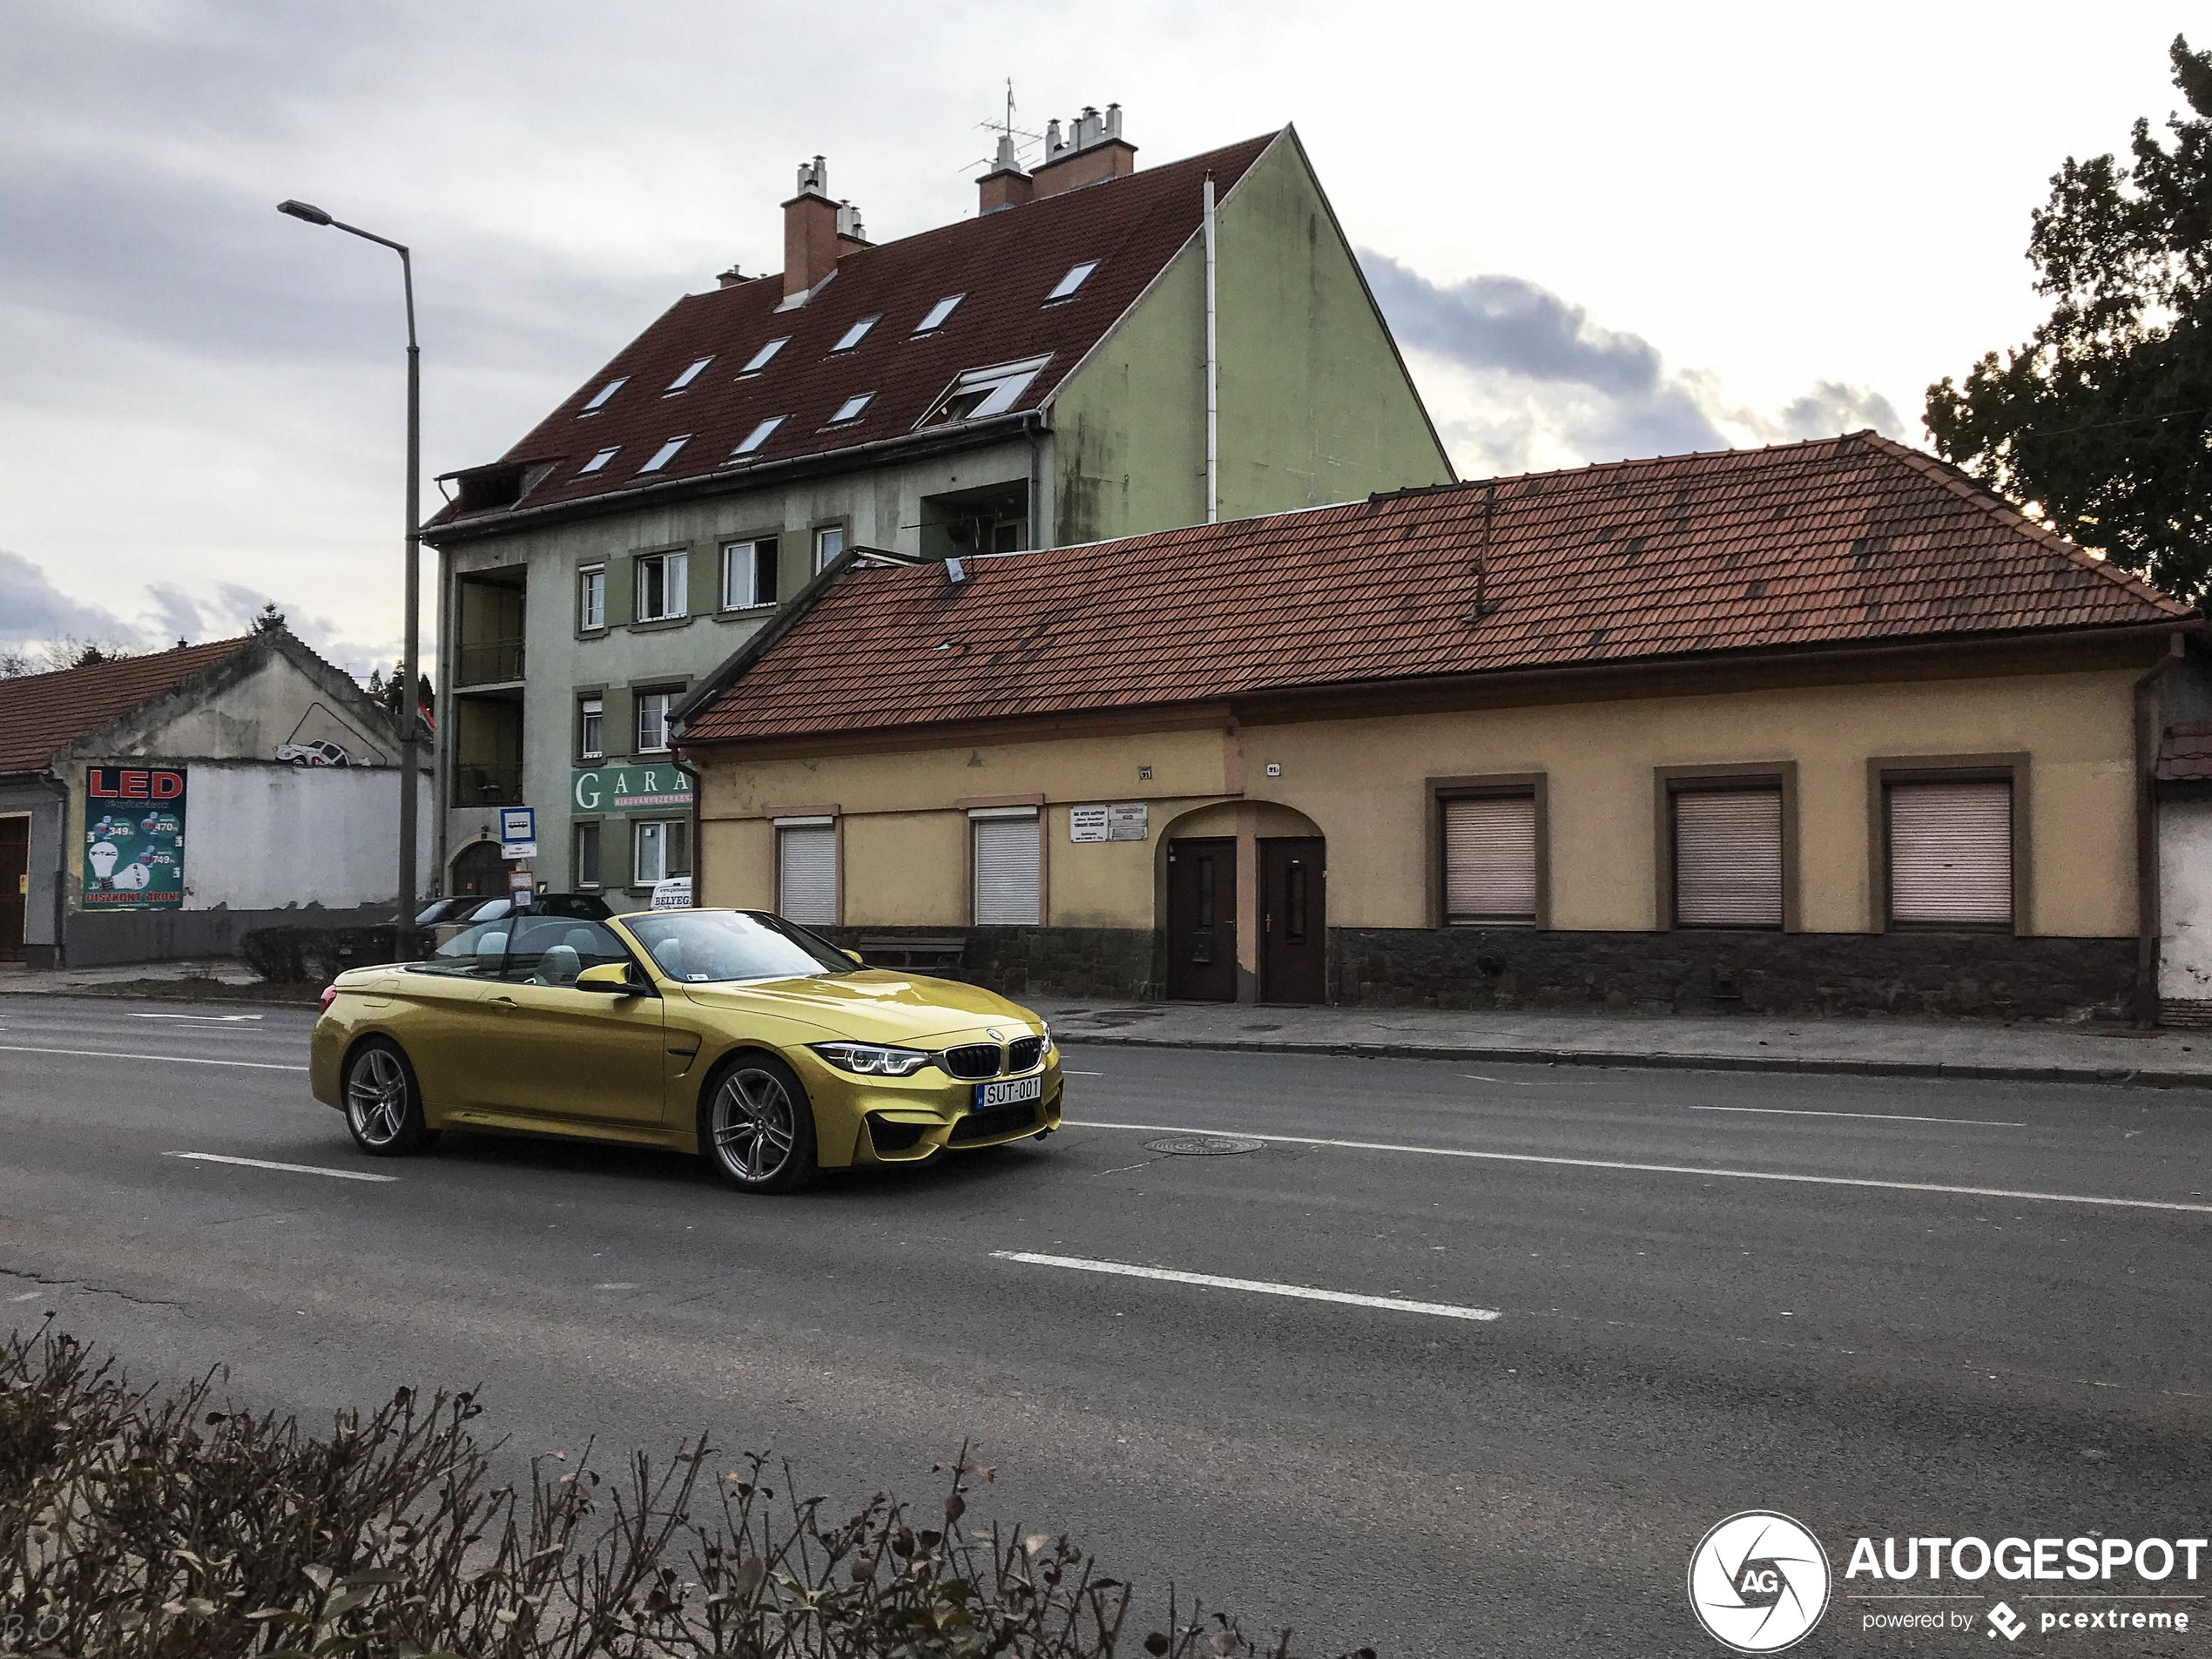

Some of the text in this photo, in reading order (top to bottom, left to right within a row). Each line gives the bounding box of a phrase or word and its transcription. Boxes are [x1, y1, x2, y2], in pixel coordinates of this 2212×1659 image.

[90, 770, 183, 799] LED
[575, 771, 689, 809] GARA
[152, 855, 170, 864] 749
[86, 891, 180, 902] DISZKONT ÁRON!
[655, 894, 691, 905] BÉLYEG
[987, 1079, 1038, 1103] SUT-001
